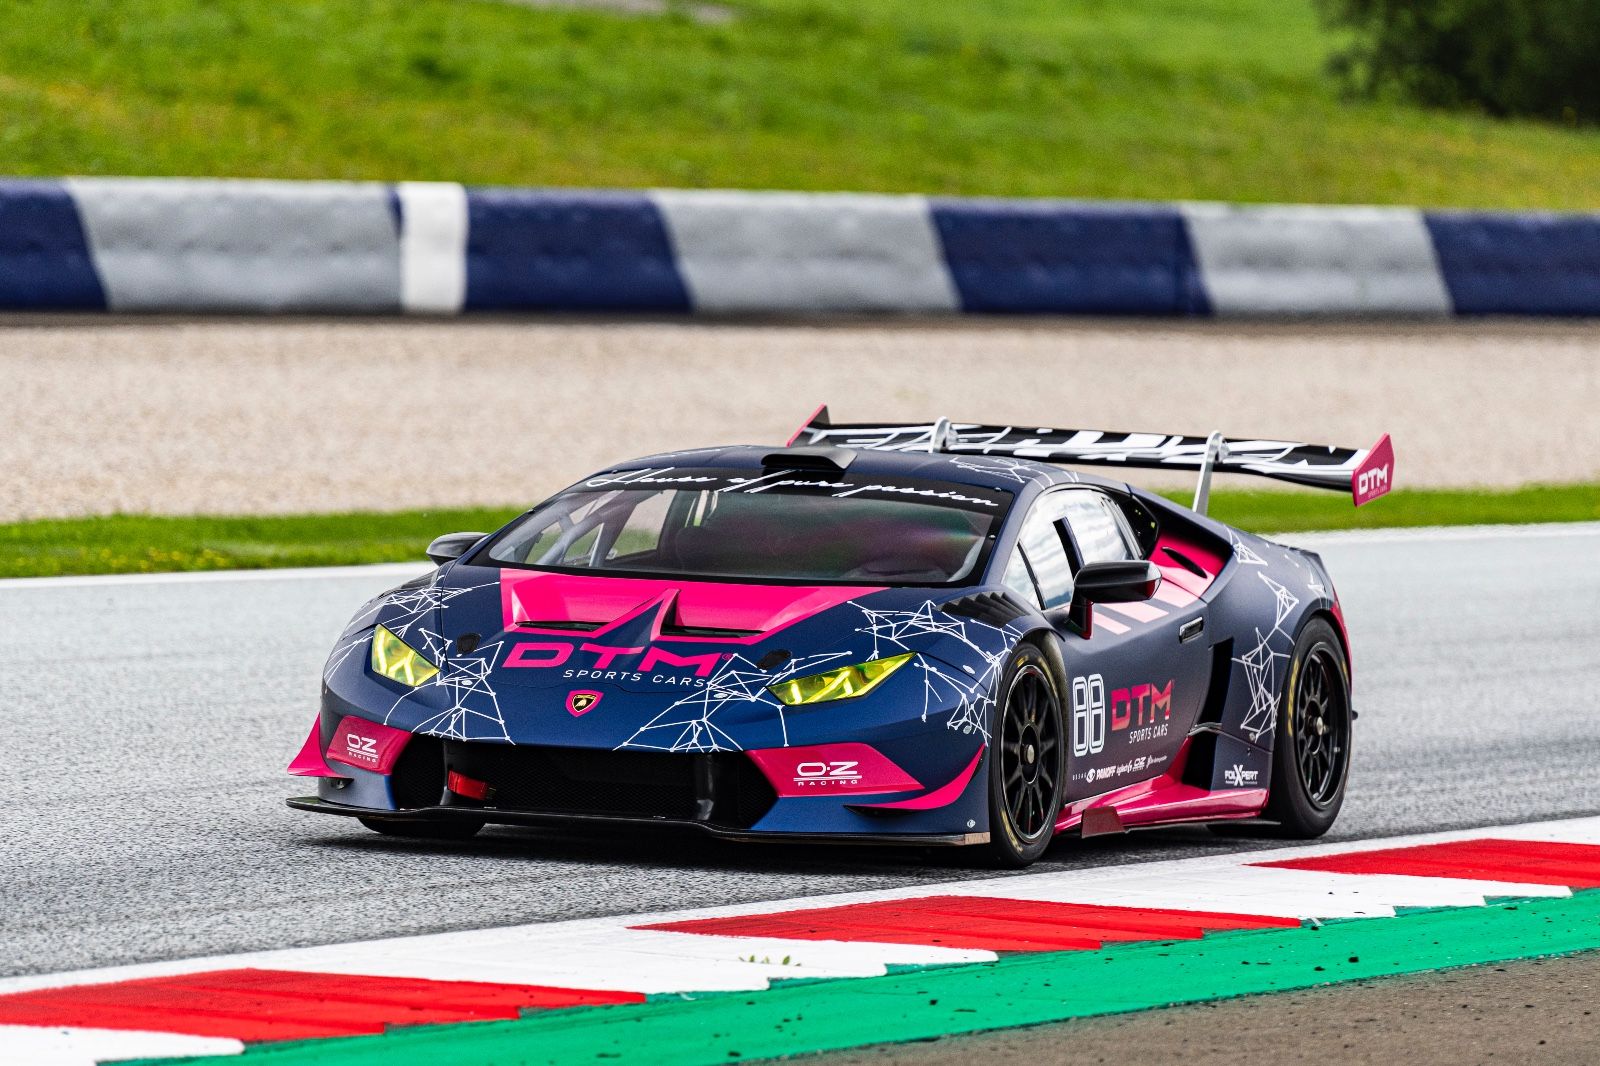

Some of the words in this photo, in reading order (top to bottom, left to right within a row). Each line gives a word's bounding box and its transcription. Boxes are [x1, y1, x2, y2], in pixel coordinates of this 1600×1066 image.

[1358, 463, 1389, 496] DTM
[832, 485, 999, 506] passion
[563, 669, 642, 681] SPORTS
[652, 674, 707, 688] CARS
[1072, 673, 1106, 757] 88
[1128, 726, 1152, 744] SPORTS
[1153, 723, 1169, 739] CARS
